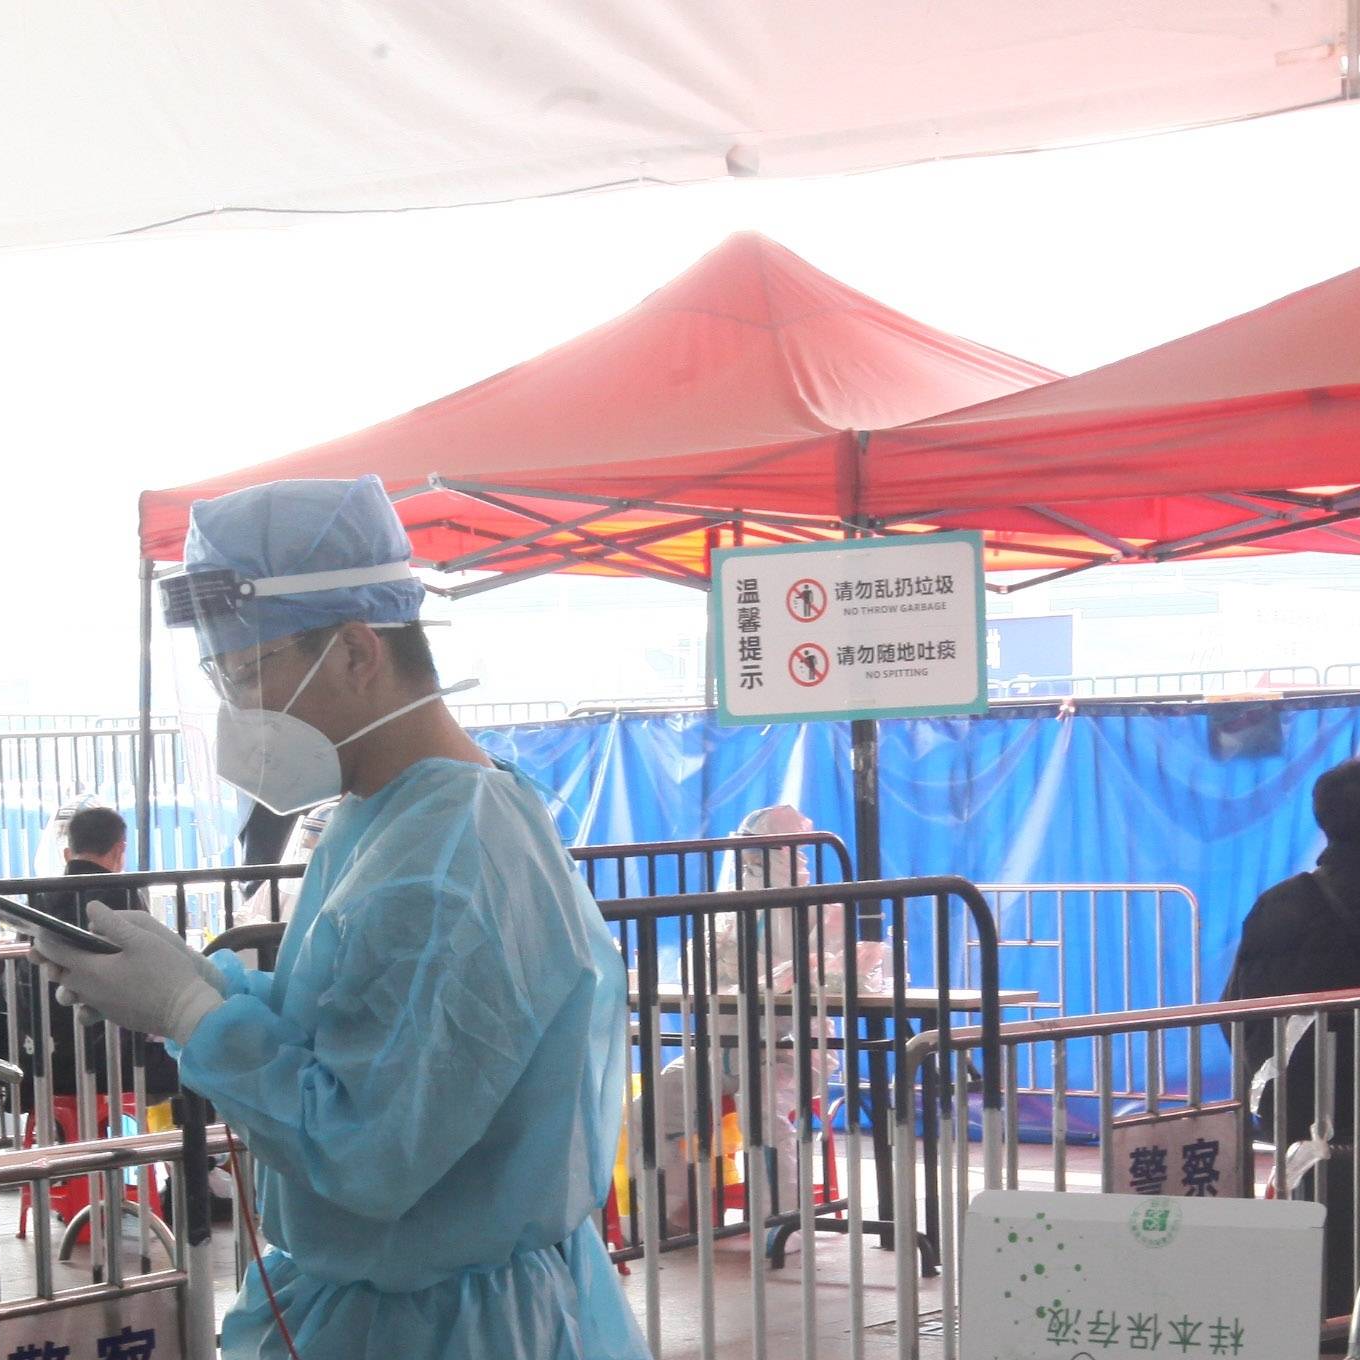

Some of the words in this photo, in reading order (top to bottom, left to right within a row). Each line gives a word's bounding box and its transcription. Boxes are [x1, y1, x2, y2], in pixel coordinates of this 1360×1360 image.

[834, 575, 954, 602] 请勿乱扔垃圾
[843, 604, 858, 616] NO
[861, 603, 898, 615] THROW
[900, 601, 947, 613] GARBAGE
[736, 579, 763, 690] 温馨提示
[837, 640, 956, 666] 请勿随地吐痰
[865, 670, 881, 680] NO
[883, 667, 928, 679] SPITTING
[1130, 1138, 1220, 1196] 警察
[1046, 1309, 1244, 1355] 样本保存液
